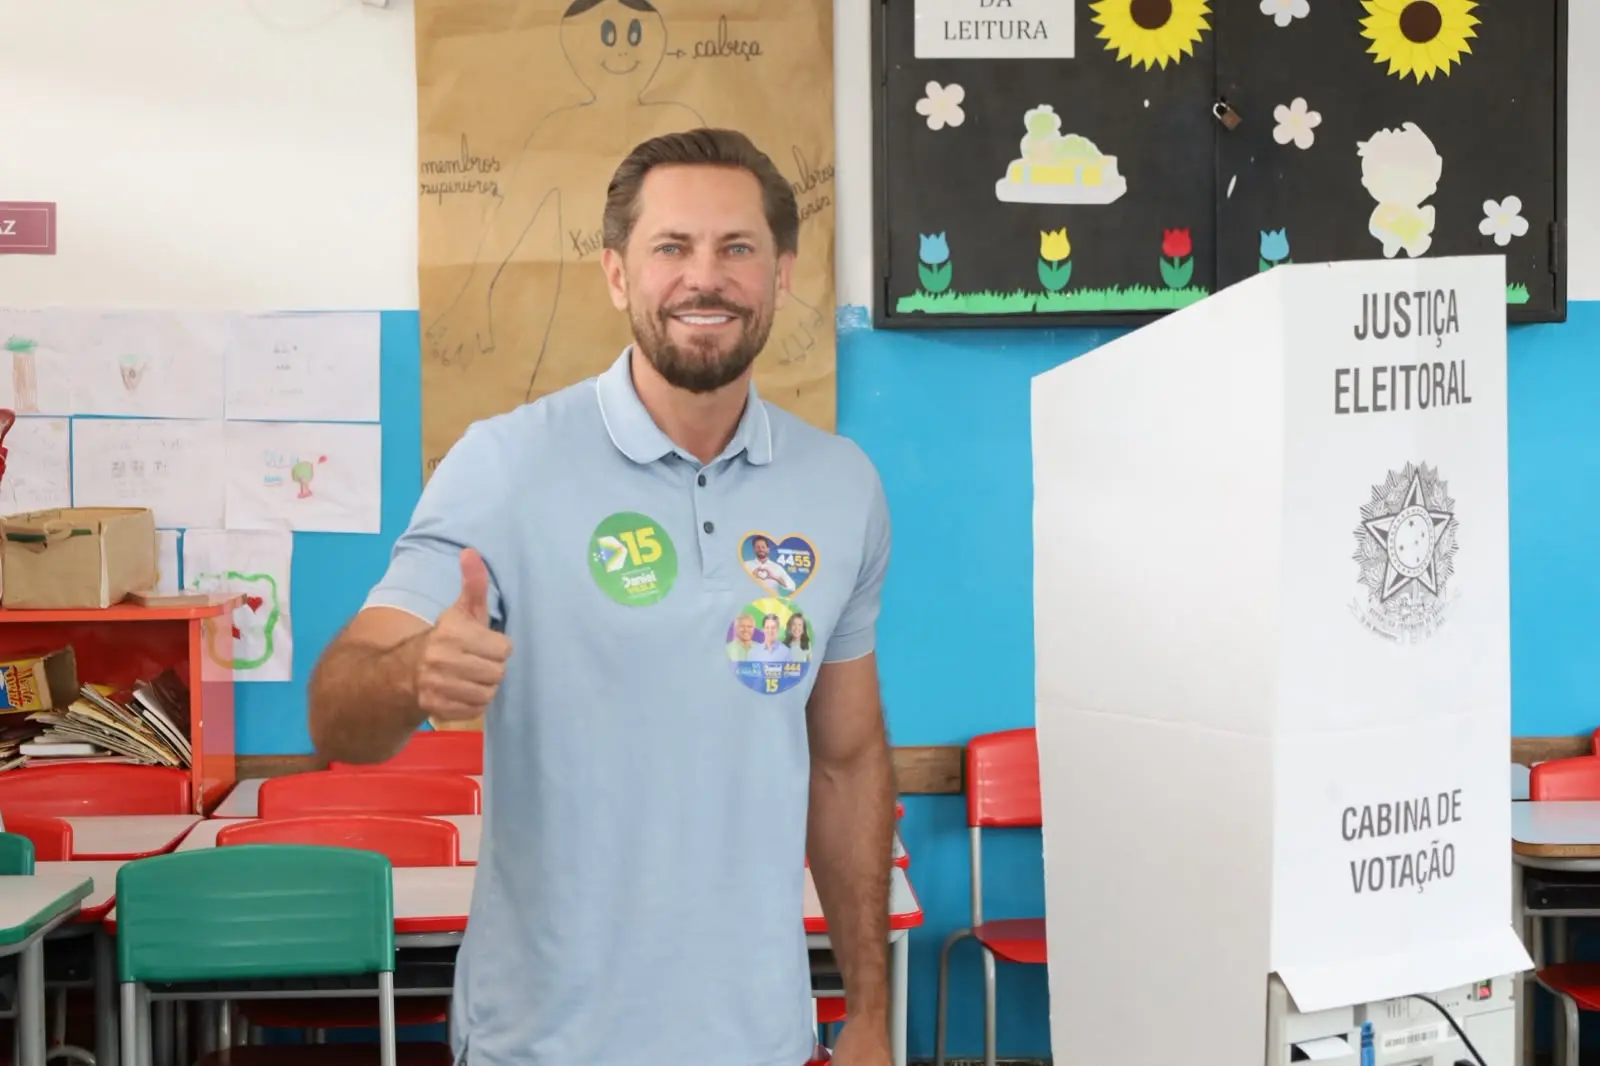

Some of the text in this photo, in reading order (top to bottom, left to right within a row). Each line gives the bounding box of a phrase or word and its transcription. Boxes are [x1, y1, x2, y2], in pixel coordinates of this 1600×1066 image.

[692, 14, 763, 61] cabeça
[944, 20, 1048, 40] LEITURA
[421, 132, 500, 174] membros
[420, 178, 500, 206] superiores
[0, 220, 16, 235] Z
[1354, 288, 1459, 348] JUSTIÇA
[1335, 359, 1472, 414] ELEITORAL
[619, 525, 662, 566] 15
[777, 553, 811, 566] 4455
[765, 677, 779, 693] 15
[1342, 788, 1462, 842] CABINA DE
[1350, 840, 1455, 894] VOTAÇÃO
